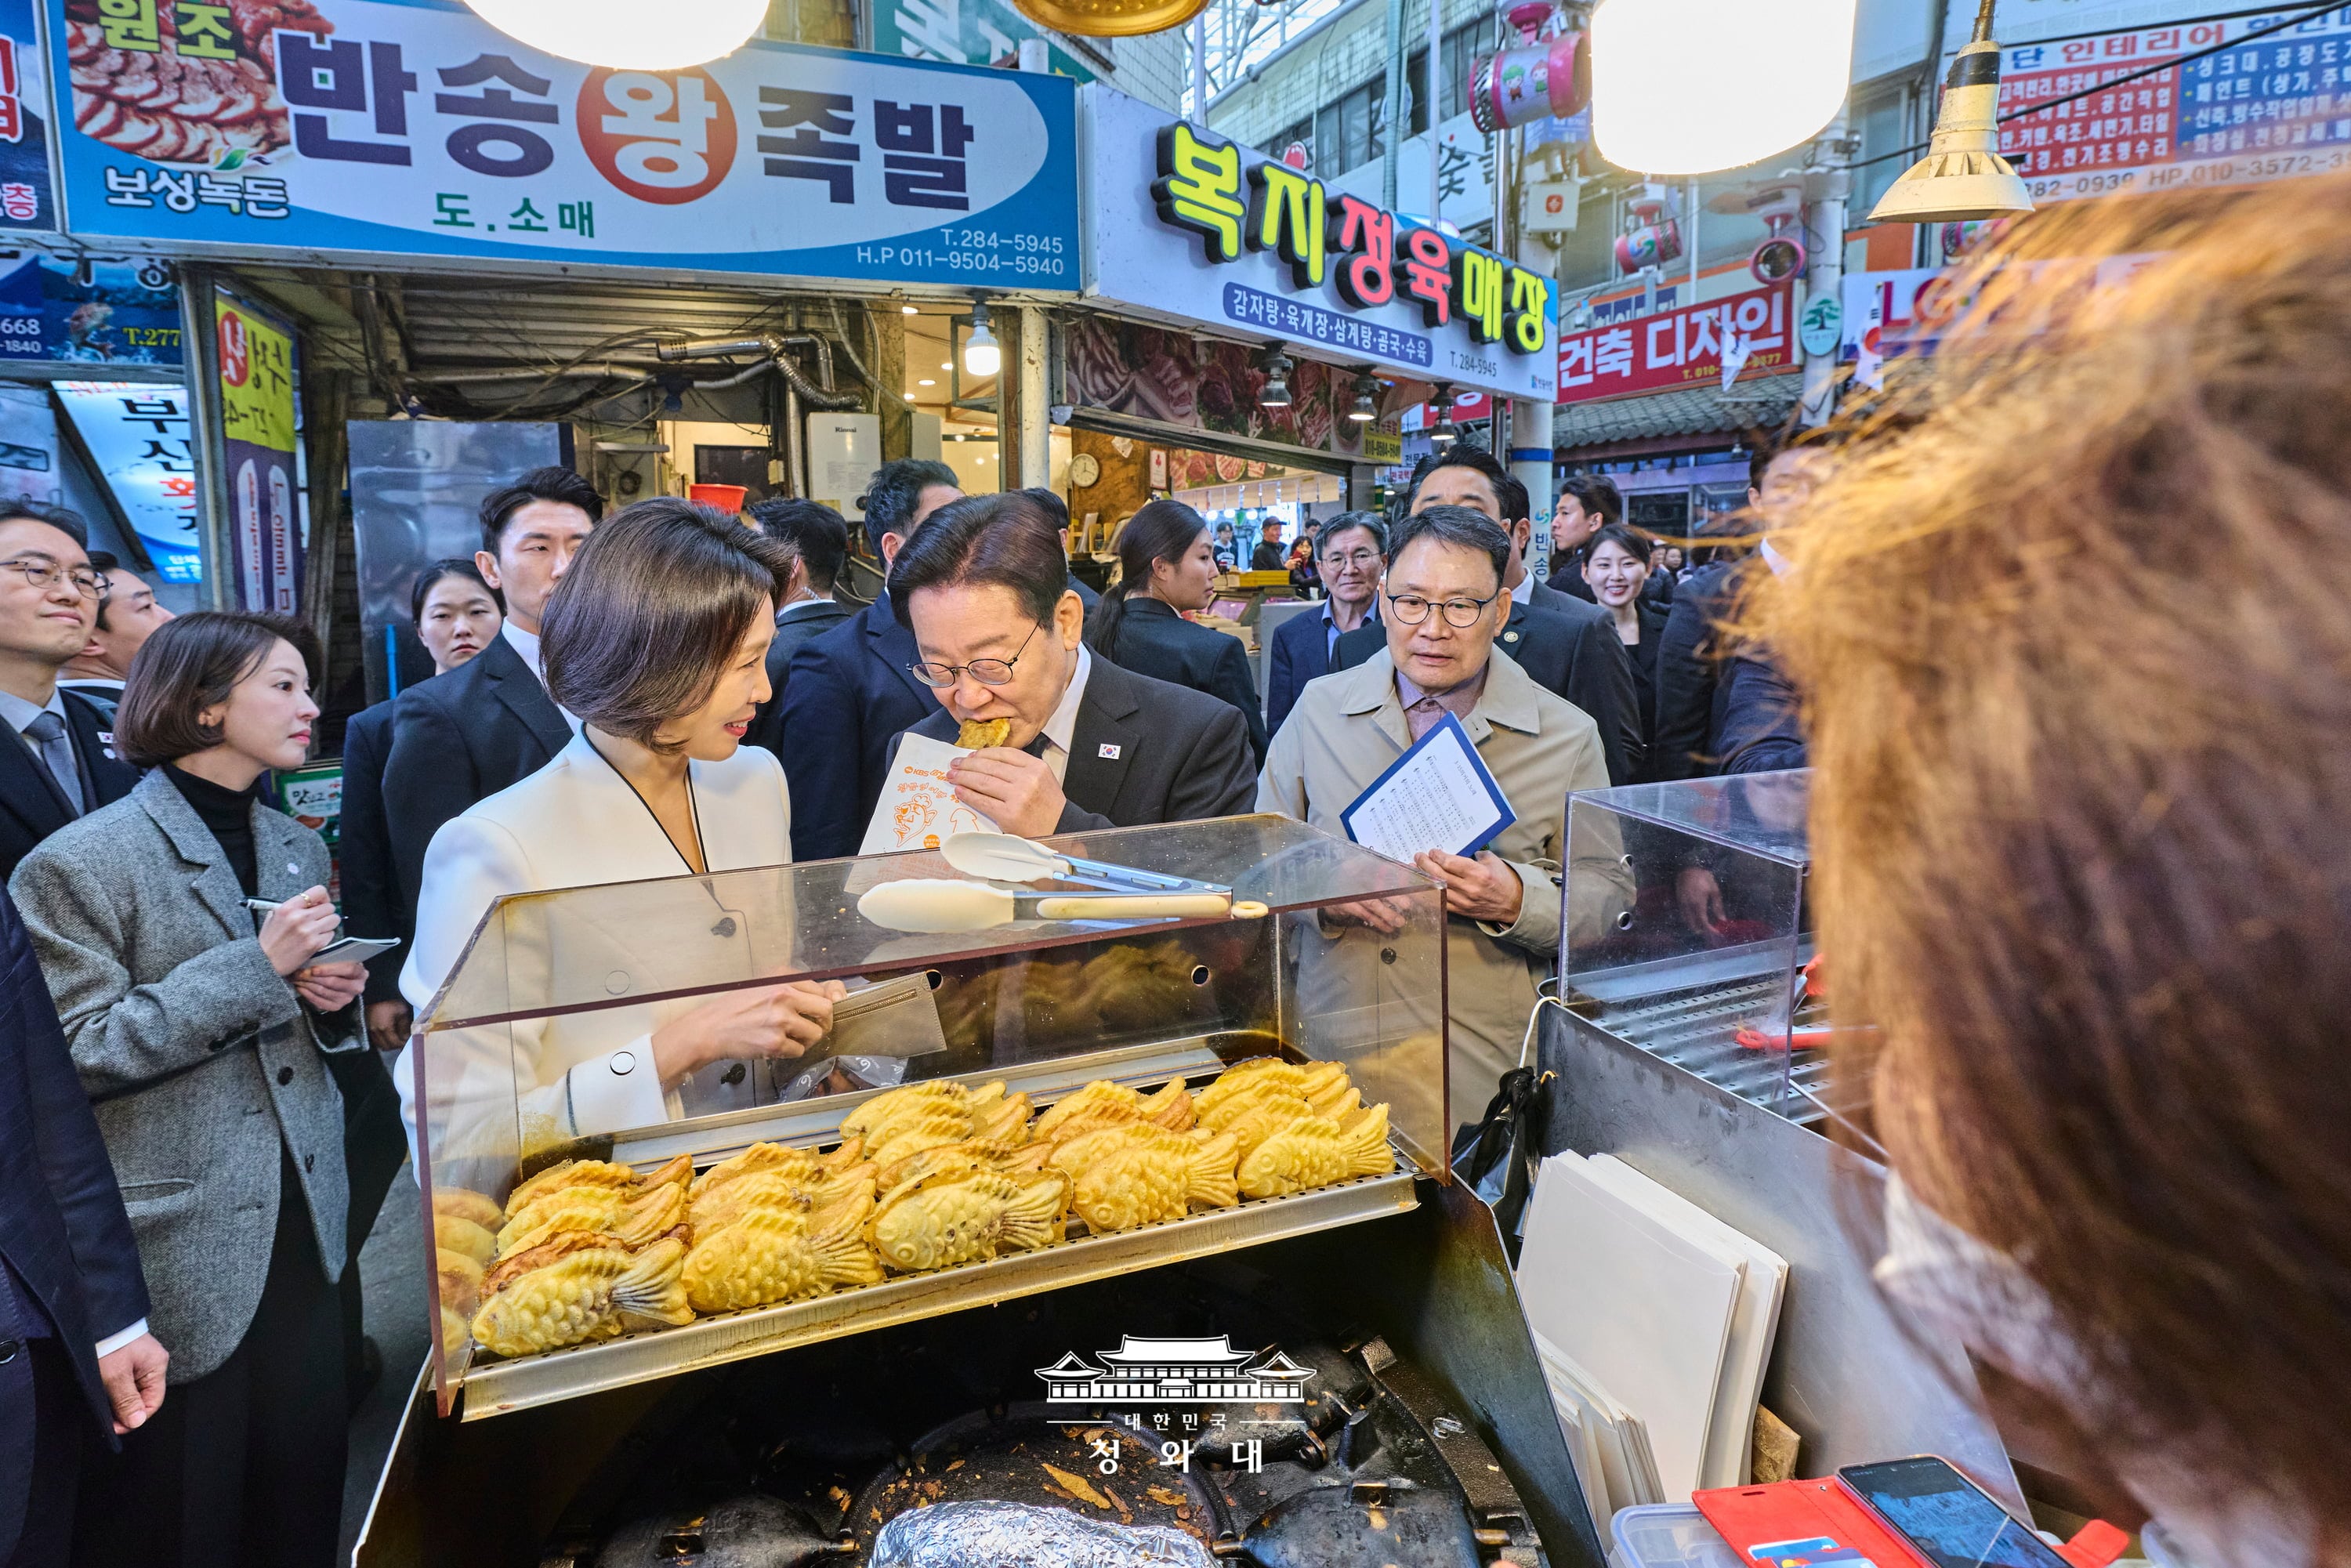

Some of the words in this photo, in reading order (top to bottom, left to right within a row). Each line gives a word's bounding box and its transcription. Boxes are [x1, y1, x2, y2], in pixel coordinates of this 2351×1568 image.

[100, 0, 236, 60] 원조
[2061, 24, 2225, 63] 인테리어
[274, 29, 558, 178] 반송
[602, 72, 717, 189] 왕
[757, 85, 974, 211] 족발
[106, 166, 290, 217] 보성녹돈
[857, 246, 893, 265] H.P
[900, 248, 1063, 276] 011-9504-5940
[1559, 328, 1634, 389] 건축
[1646, 291, 1784, 370] 디자인
[1459, 353, 1498, 378] 284-5945
[1534, 533, 1549, 576] 반송
